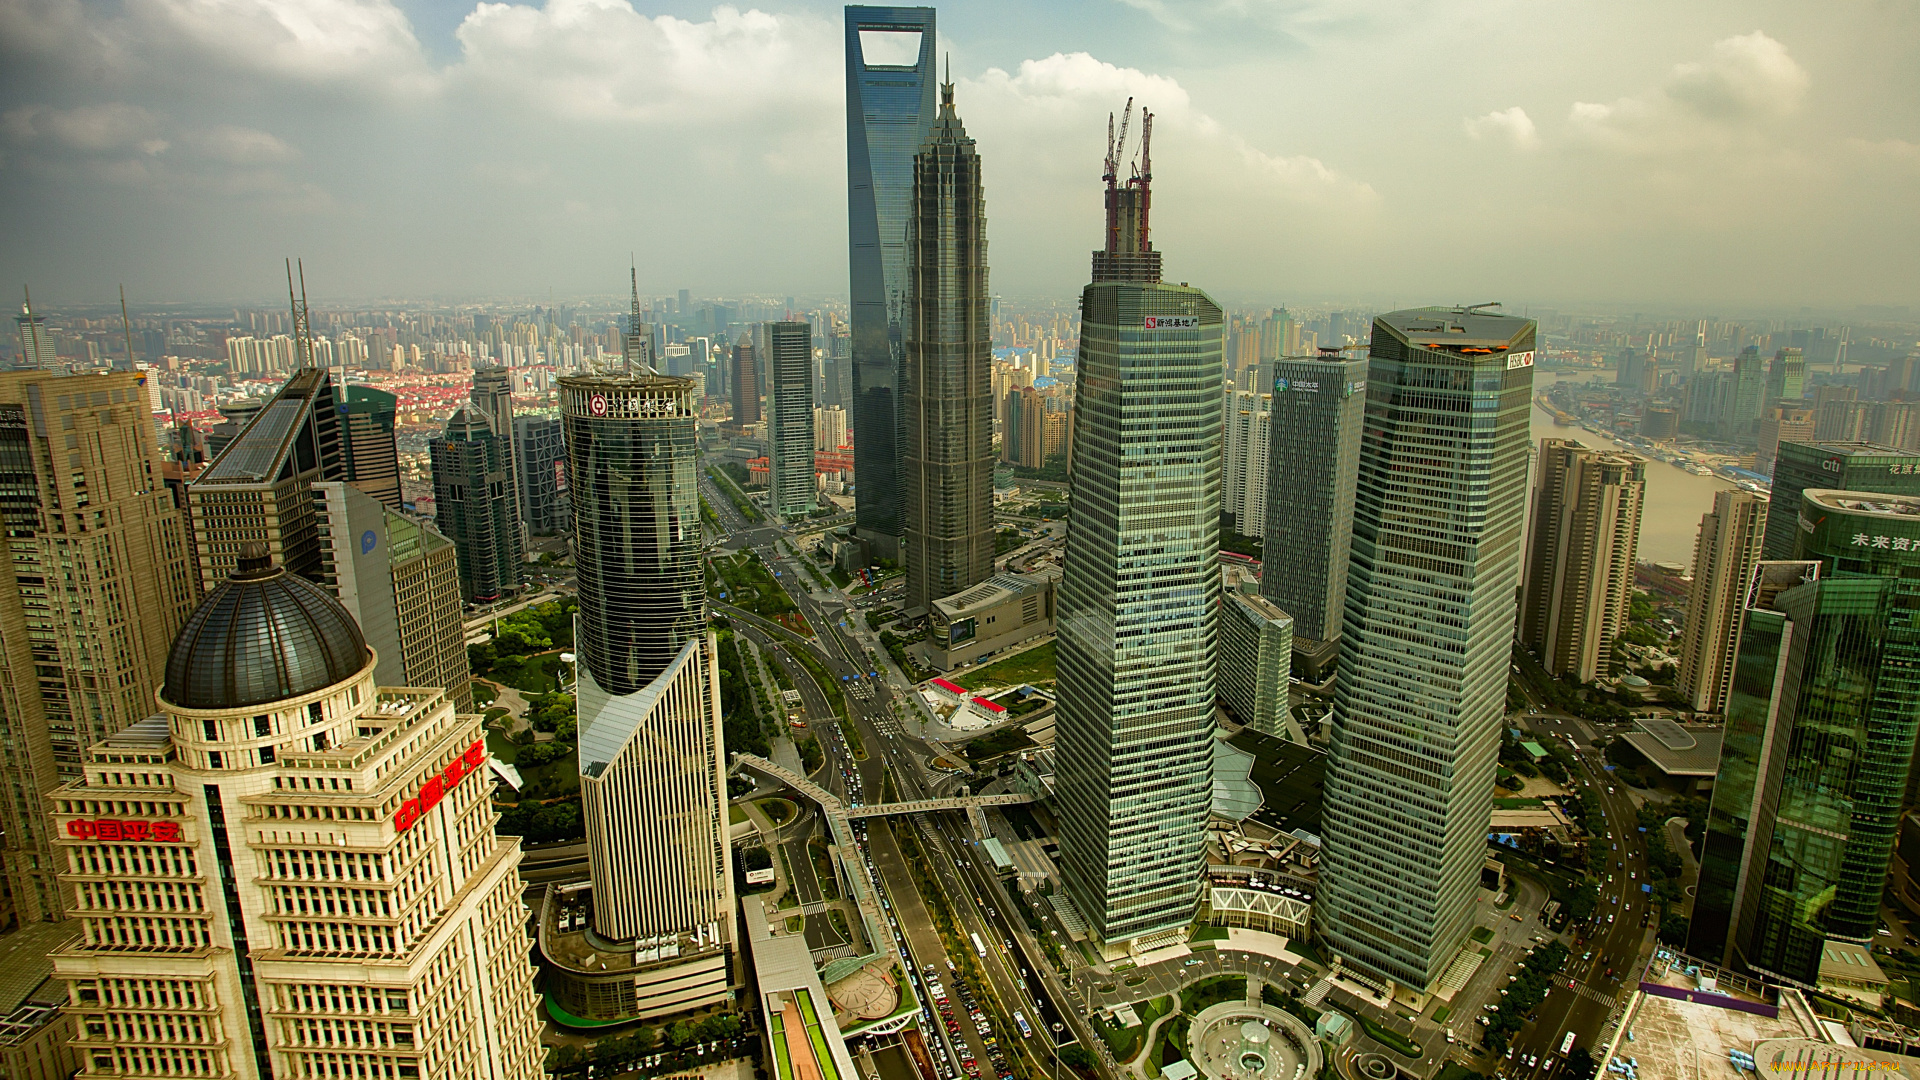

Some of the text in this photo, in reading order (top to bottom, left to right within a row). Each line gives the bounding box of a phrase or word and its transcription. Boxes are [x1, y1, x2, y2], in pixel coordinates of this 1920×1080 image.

[1509, 353, 1524, 368] HSBC
[613, 397, 677, 415] 中国银行
[1822, 457, 1840, 473] citi
[394, 739, 485, 832] 中国平安
[66, 818, 181, 842] 中国平安
